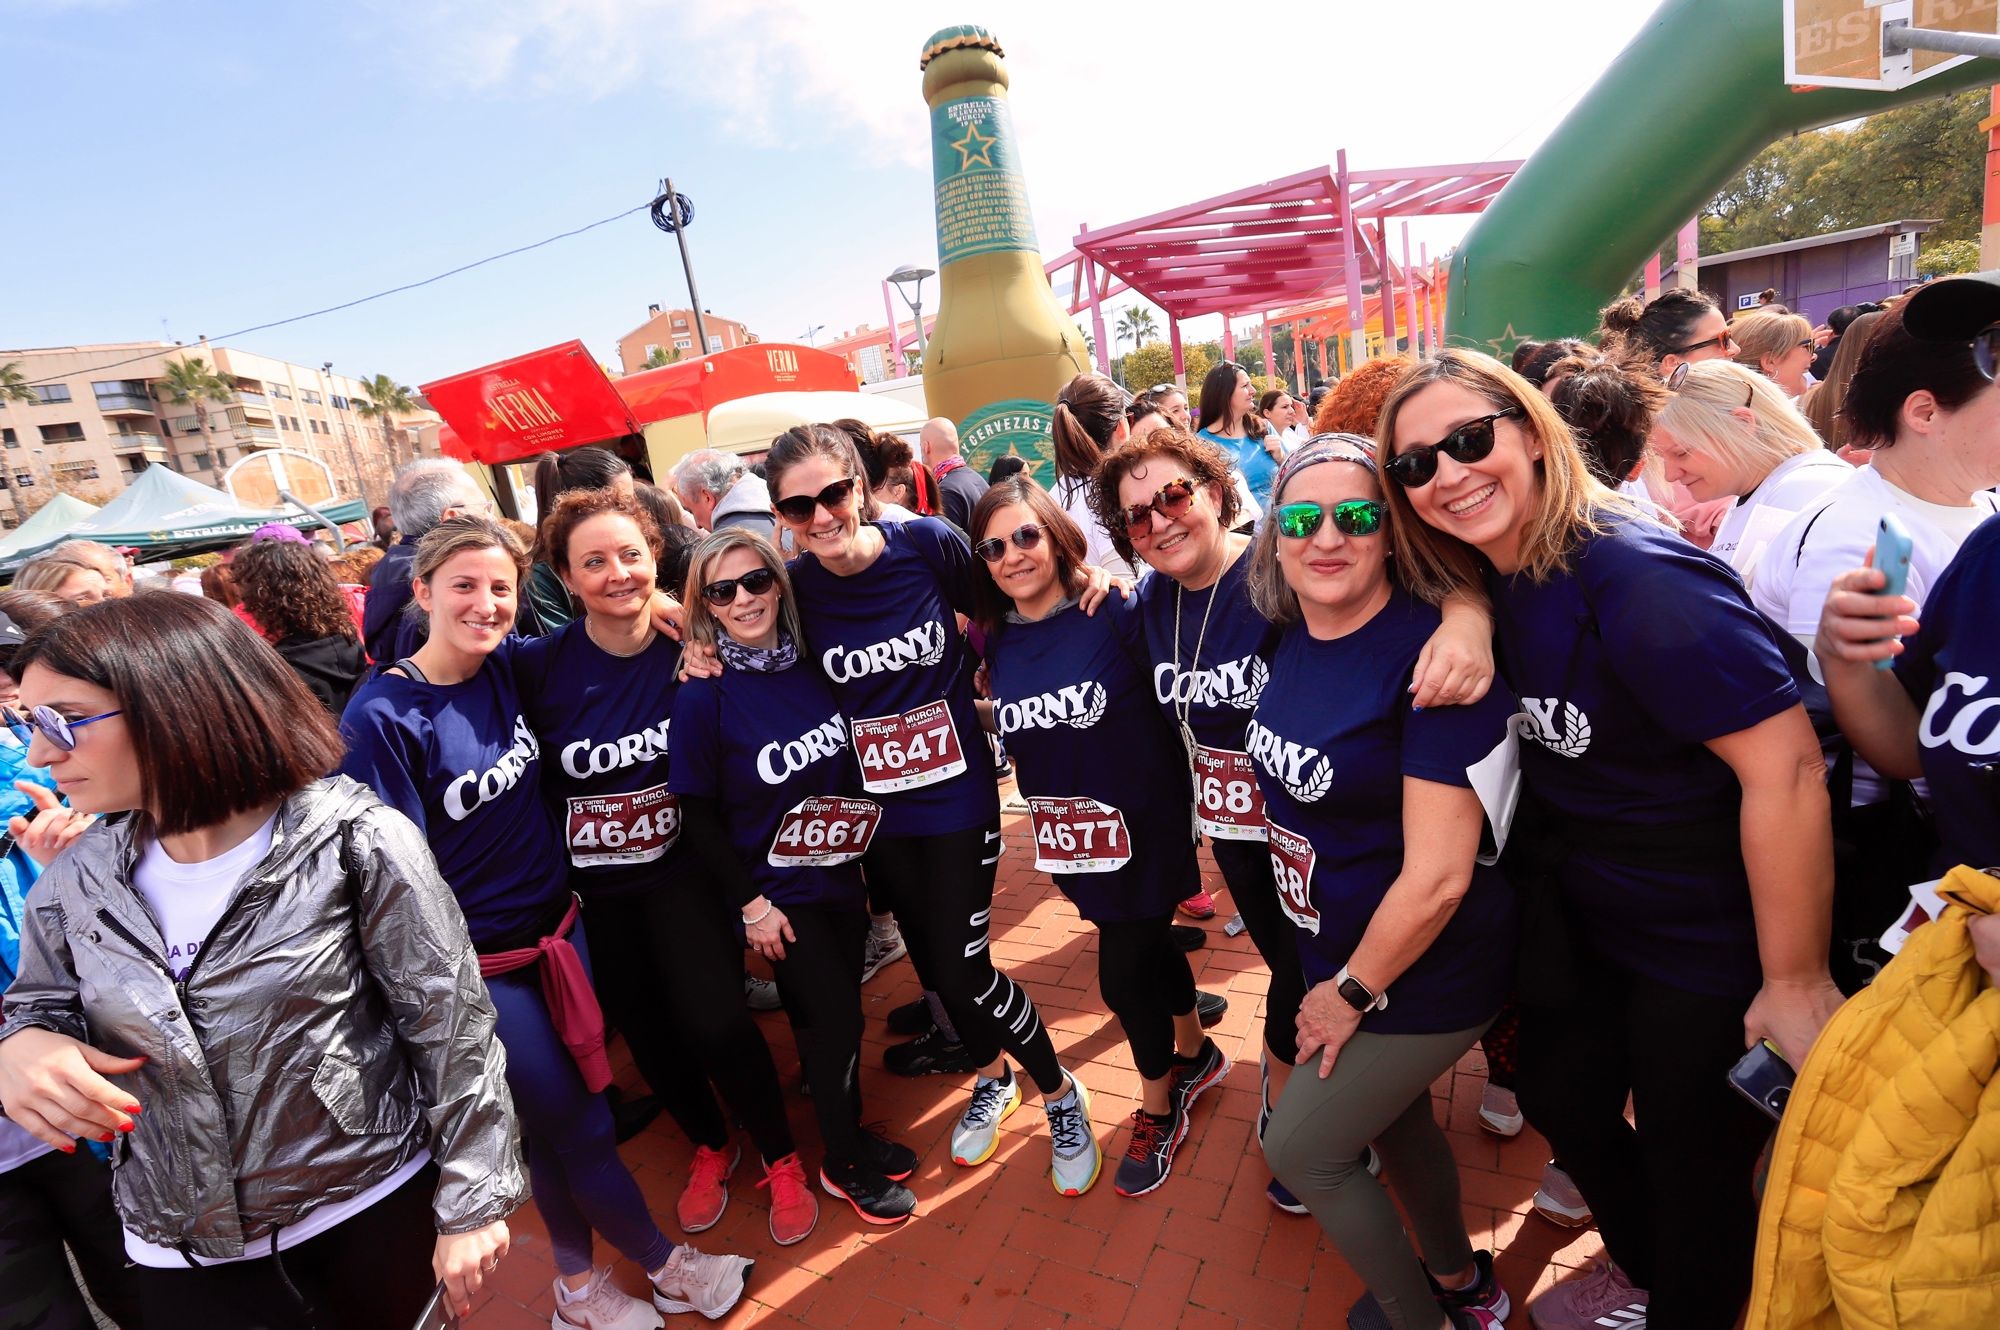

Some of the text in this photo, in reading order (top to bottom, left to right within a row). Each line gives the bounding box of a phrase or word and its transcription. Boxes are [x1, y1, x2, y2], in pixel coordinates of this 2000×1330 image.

[948, 101, 991, 114] ESTRELLA
[959, 107, 992, 116] LEVANTE
[956, 113, 986, 123] MURCIA
[766, 350, 799, 372] VERNA
[484, 387, 563, 432] VERNA
[537, 428, 564, 438] LIMONES
[541, 433, 564, 442] MURCIA
[961, 443, 971, 454] Y
[969, 417, 1041, 448] CERVEZAS
[173, 523, 248, 539] ESTRELLA
[823, 620, 934, 683] CORNY
[1154, 655, 1251, 707] CORNY
[905, 706, 943, 724] MURCIA
[869, 723, 898, 738] mujer
[561, 718, 671, 779] CORN
[862, 724, 950, 771] 4647
[1245, 718, 1319, 786] ORNY
[1198, 755, 1225, 773] mujer
[1234, 757, 1252, 767] MU
[901, 767, 919, 776] DOLO
[632, 789, 669, 805] MURCI
[1196, 772, 1263, 814] 68
[591, 803, 623, 818] mujer
[803, 802, 833, 816] mujer
[840, 801, 876, 811] MURCIA
[1044, 805, 1068, 819] mujer
[1074, 800, 1097, 810] MUR
[1214, 814, 1235, 823] PACA
[572, 807, 677, 848] 4648
[779, 819, 868, 847] 4661
[1038, 820, 1120, 851] 4677
[1271, 828, 1307, 855] MURCIA
[1270, 852, 1306, 908] 88
